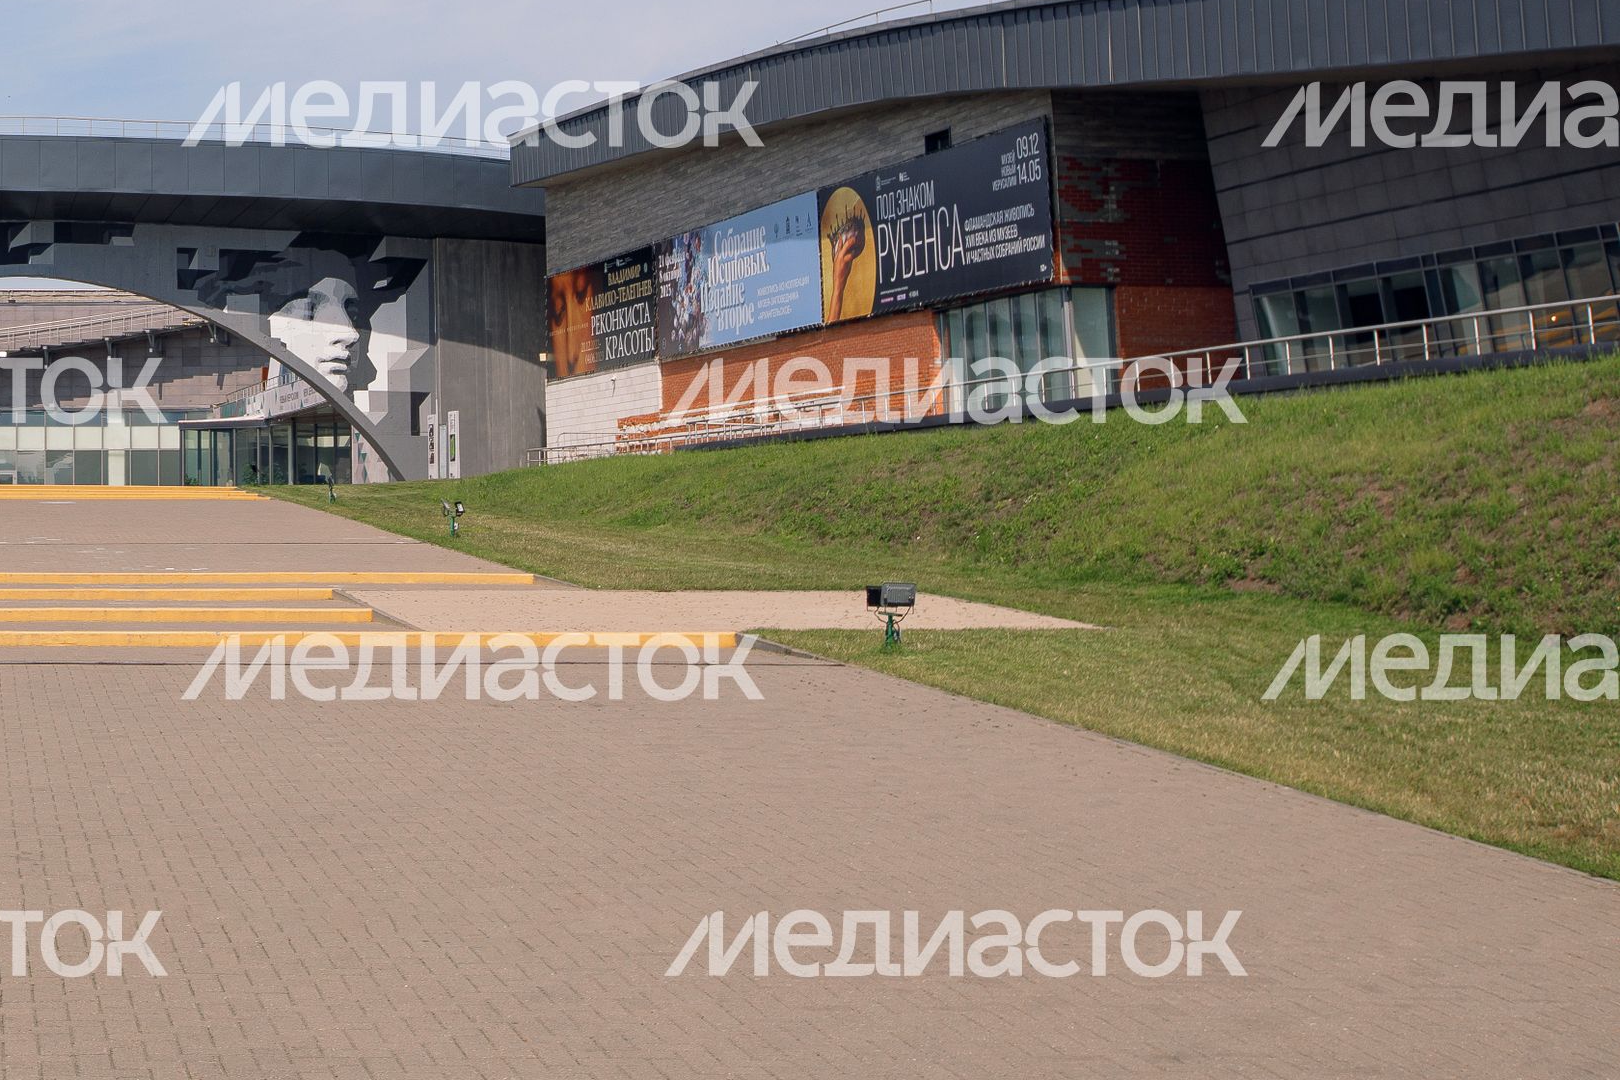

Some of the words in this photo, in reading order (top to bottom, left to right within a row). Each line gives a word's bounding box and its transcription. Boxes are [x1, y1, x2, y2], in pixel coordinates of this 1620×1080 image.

[1016, 132, 1040, 160] 09.12
[1016, 158, 1041, 185] 14.05
[876, 192, 896, 221] ПОД
[896, 180, 935, 216] ЗНАКОМ
[964, 210, 1004, 233] ФЛАМАНДСКАЯ
[1004, 202, 1035, 222] ЖИВОПИСЬ
[714, 225, 766, 260] Собрание
[877, 203, 966, 284] РУБЕНСА
[970, 245, 995, 263] ЧАСТНЫХ
[995, 237, 1023, 259] СОБРАНИЙ
[1023, 234, 1046, 253] РОССИИ
[975, 229, 989, 247] ВЕКА
[996, 224, 1019, 241] МУЗЕЕВ
[607, 264, 641, 286] ВЛАДИМИР
[707, 250, 770, 288] Юсуповых.
[700, 281, 745, 314] Издание
[591, 301, 651, 336] РЕКОНКИСТА
[718, 302, 755, 335] второе
[605, 327, 655, 360] КРАСОТЫ
